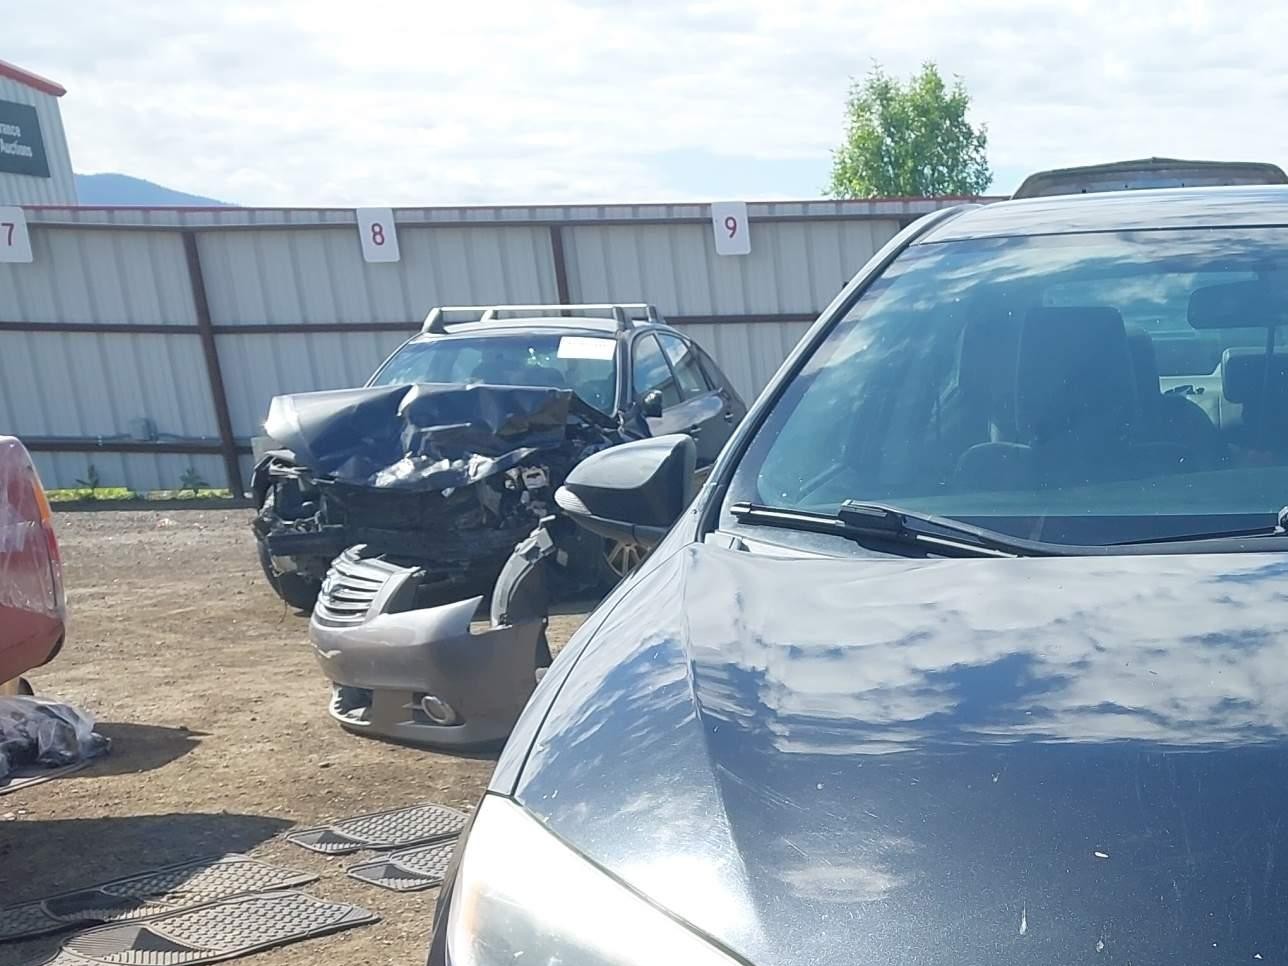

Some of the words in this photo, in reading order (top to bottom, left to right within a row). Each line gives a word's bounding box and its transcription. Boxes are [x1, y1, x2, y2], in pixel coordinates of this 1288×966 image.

[1, 222, 15, 246] 7
[371, 222, 386, 246] 8
[724, 216, 738, 239] 9
